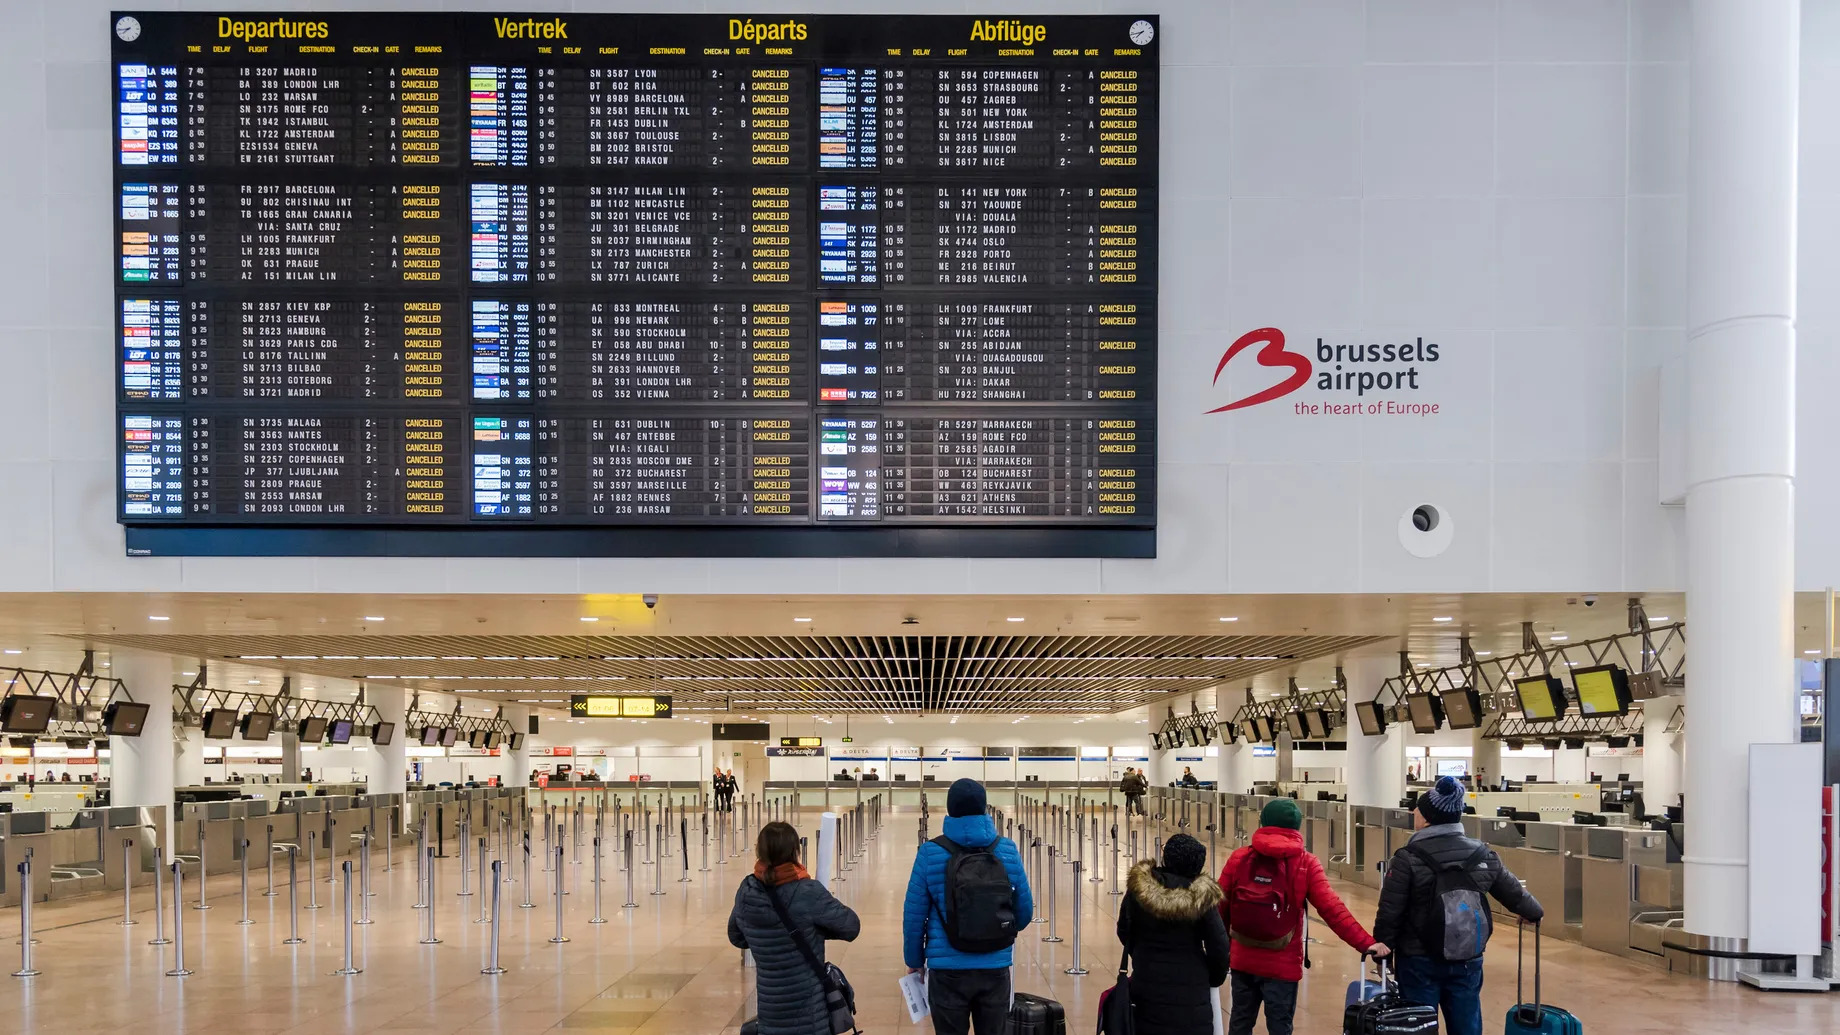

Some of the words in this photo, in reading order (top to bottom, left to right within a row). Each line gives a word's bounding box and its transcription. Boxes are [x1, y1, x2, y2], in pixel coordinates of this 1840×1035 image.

[219, 17, 328, 42] Departures
[494, 18, 567, 39] Vertrek
[729, 19, 807, 44] Départs
[970, 20, 1046, 46] Abflüge
[188, 45, 200, 53] TIME
[213, 45, 230, 53] DELAY
[248, 45, 268, 54] FLIGHT
[299, 45, 335, 53] DESTINATION
[385, 45, 399, 53] GATE
[415, 45, 442, 53] REMARKS
[539, 46, 552, 54] TIME
[564, 47, 581, 55] DELAY
[600, 47, 618, 55] FLIGHT
[650, 47, 685, 55] DESTINATION
[736, 47, 750, 55] GATE
[765, 47, 792, 55] REMARKS
[888, 48, 901, 56] TIME
[913, 48, 930, 57] DELAY
[948, 48, 966, 57] FLIGHT
[999, 48, 1034, 57] DESTINATION
[1085, 48, 1098, 57] GATE
[1114, 48, 1140, 56] REMARKS
[147, 68, 156, 76] LA
[160, 68, 177, 76] 5444
[240, 67, 250, 76] IB
[256, 67, 278, 77] 3207
[283, 67, 317, 77] MADRID
[401, 67, 439, 77] CANCELLED
[589, 81, 601, 90] BT
[612, 81, 629, 91] 602
[634, 81, 657, 91] RIGA
[751, 82, 789, 91] CANCELLED
[983, 83, 1039, 92] STRASBOURG
[283, 92, 318, 101] WARSAW
[938, 95, 950, 105] OU
[961, 95, 977, 105] 457
[983, 95, 1017, 105] ZAGREB
[1100, 95, 1138, 104] CANCELLED
[239, 104, 251, 114] SN
[256, 105, 279, 114] 3175
[284, 104, 306, 114] ROME
[312, 105, 329, 114] FCO
[401, 105, 440, 114] CANCELLED
[634, 106, 668, 116] BERLIN
[673, 106, 690, 116] TXL
[285, 117, 328, 126] ISTANBUL
[983, 120, 1033, 129] AMSTERDAM
[635, 143, 674, 153] BRISTOL
[983, 145, 1017, 154] MUNICH
[240, 185, 252, 194] FR
[257, 185, 280, 194] 2917
[285, 185, 336, 194] BARCELONA
[402, 185, 441, 194] CANCELLED
[590, 186, 601, 195] SN
[607, 186, 629, 196] 3147
[634, 186, 663, 196] MILAN
[668, 187, 686, 196] LIN
[752, 187, 790, 196] CANCELLED
[938, 188, 949, 197] DL
[962, 188, 976, 197] 141
[982, 188, 1000, 197] NEW
[1005, 188, 1027, 197] YORK
[1099, 188, 1137, 197] CANCELLED
[285, 197, 330, 207] CHISINAU
[336, 197, 351, 207] INT
[983, 200, 1022, 210] YAOUNDE
[285, 210, 308, 219] GRAN
[313, 210, 352, 219] CANARIA
[635, 211, 668, 221] VENICE
[674, 211, 691, 221] VCE
[983, 212, 1016, 222] DOUALA
[257, 222, 279, 231] VIA:
[285, 222, 314, 231] SANTA
[319, 222, 341, 231] CRUZ
[635, 224, 679, 233] BELGRADE
[983, 225, 1017, 234] MADRID
[285, 234, 335, 244] FRANKFURT
[983, 237, 1005, 246] OSLO
[635, 248, 691, 258] MANCHESTER
[285, 271, 314, 280] MILAN
[319, 272, 337, 281] LIN
[635, 273, 680, 282] ALICANTE
[242, 302, 253, 311] SN
[259, 302, 281, 311] 2857
[286, 302, 309, 311] KIEV
[314, 302, 331, 311] KBP
[403, 302, 442, 311] CANCELLED
[591, 303, 603, 312] AC
[614, 303, 630, 313] 833
[635, 303, 680, 313] MONTREAL
[752, 303, 790, 313] CANCELLED
[983, 304, 1033, 314] FRANKFURT
[983, 329, 1011, 338] ACCRA
[287, 339, 315, 348] PARIS
[320, 339, 338, 348] CDG
[636, 340, 653, 350] ABU
[658, 340, 685, 350] DHABI
[1317, 337, 1439, 362] brussels
[982, 353, 1044, 363] OUAGADOUGOU
[636, 377, 670, 386] LONDON
[675, 377, 692, 386] LHR
[1317, 365, 1418, 396] airport
[287, 388, 321, 397] MADRID
[938, 390, 950, 399] HU
[955, 390, 977, 399] 7922
[982, 390, 1026, 399] SHANGHAI
[1098, 390, 1136, 399] CANCELLED
[1295, 402, 1318, 415] the
[1324, 402, 1363, 415] heart
[1368, 401, 1382, 415] of
[1387, 402, 1439, 417] Europe
[287, 418, 322, 427] MALAGA
[636, 420, 670, 429] DUBLIN
[243, 430, 255, 439] SN
[260, 430, 283, 439] 3563
[288, 430, 322, 440] NANTES
[405, 431, 443, 440] CANCELLED
[637, 432, 676, 441] ENTEBBE
[939, 433, 949, 441] AZ
[961, 433, 977, 441] 159
[983, 433, 1005, 441] ROME
[1011, 433, 1027, 441] FCO
[1098, 432, 1136, 441] CANCELLED
[288, 442, 339, 452] STOCKHOLM
[609, 444, 631, 453] VIA:
[636, 444, 669, 453] KIGALI
[983, 445, 1016, 453] AGADIR
[593, 456, 604, 465] SN
[609, 456, 632, 465] 2835
[636, 456, 671, 465] MOSCOW
[676, 456, 692, 465] DME
[753, 456, 791, 465] CANCELLED
[983, 457, 1032, 465] MARRAKECH
[289, 467, 339, 476] LJUBLJANA
[983, 469, 1032, 477] BUCHAREST
[288, 479, 322, 488] PRAGUE
[637, 481, 687, 490] MARSEILLE
[289, 504, 323, 513] LONDON
[328, 504, 345, 513] LHR
[983, 506, 1027, 514] HELSINKI
